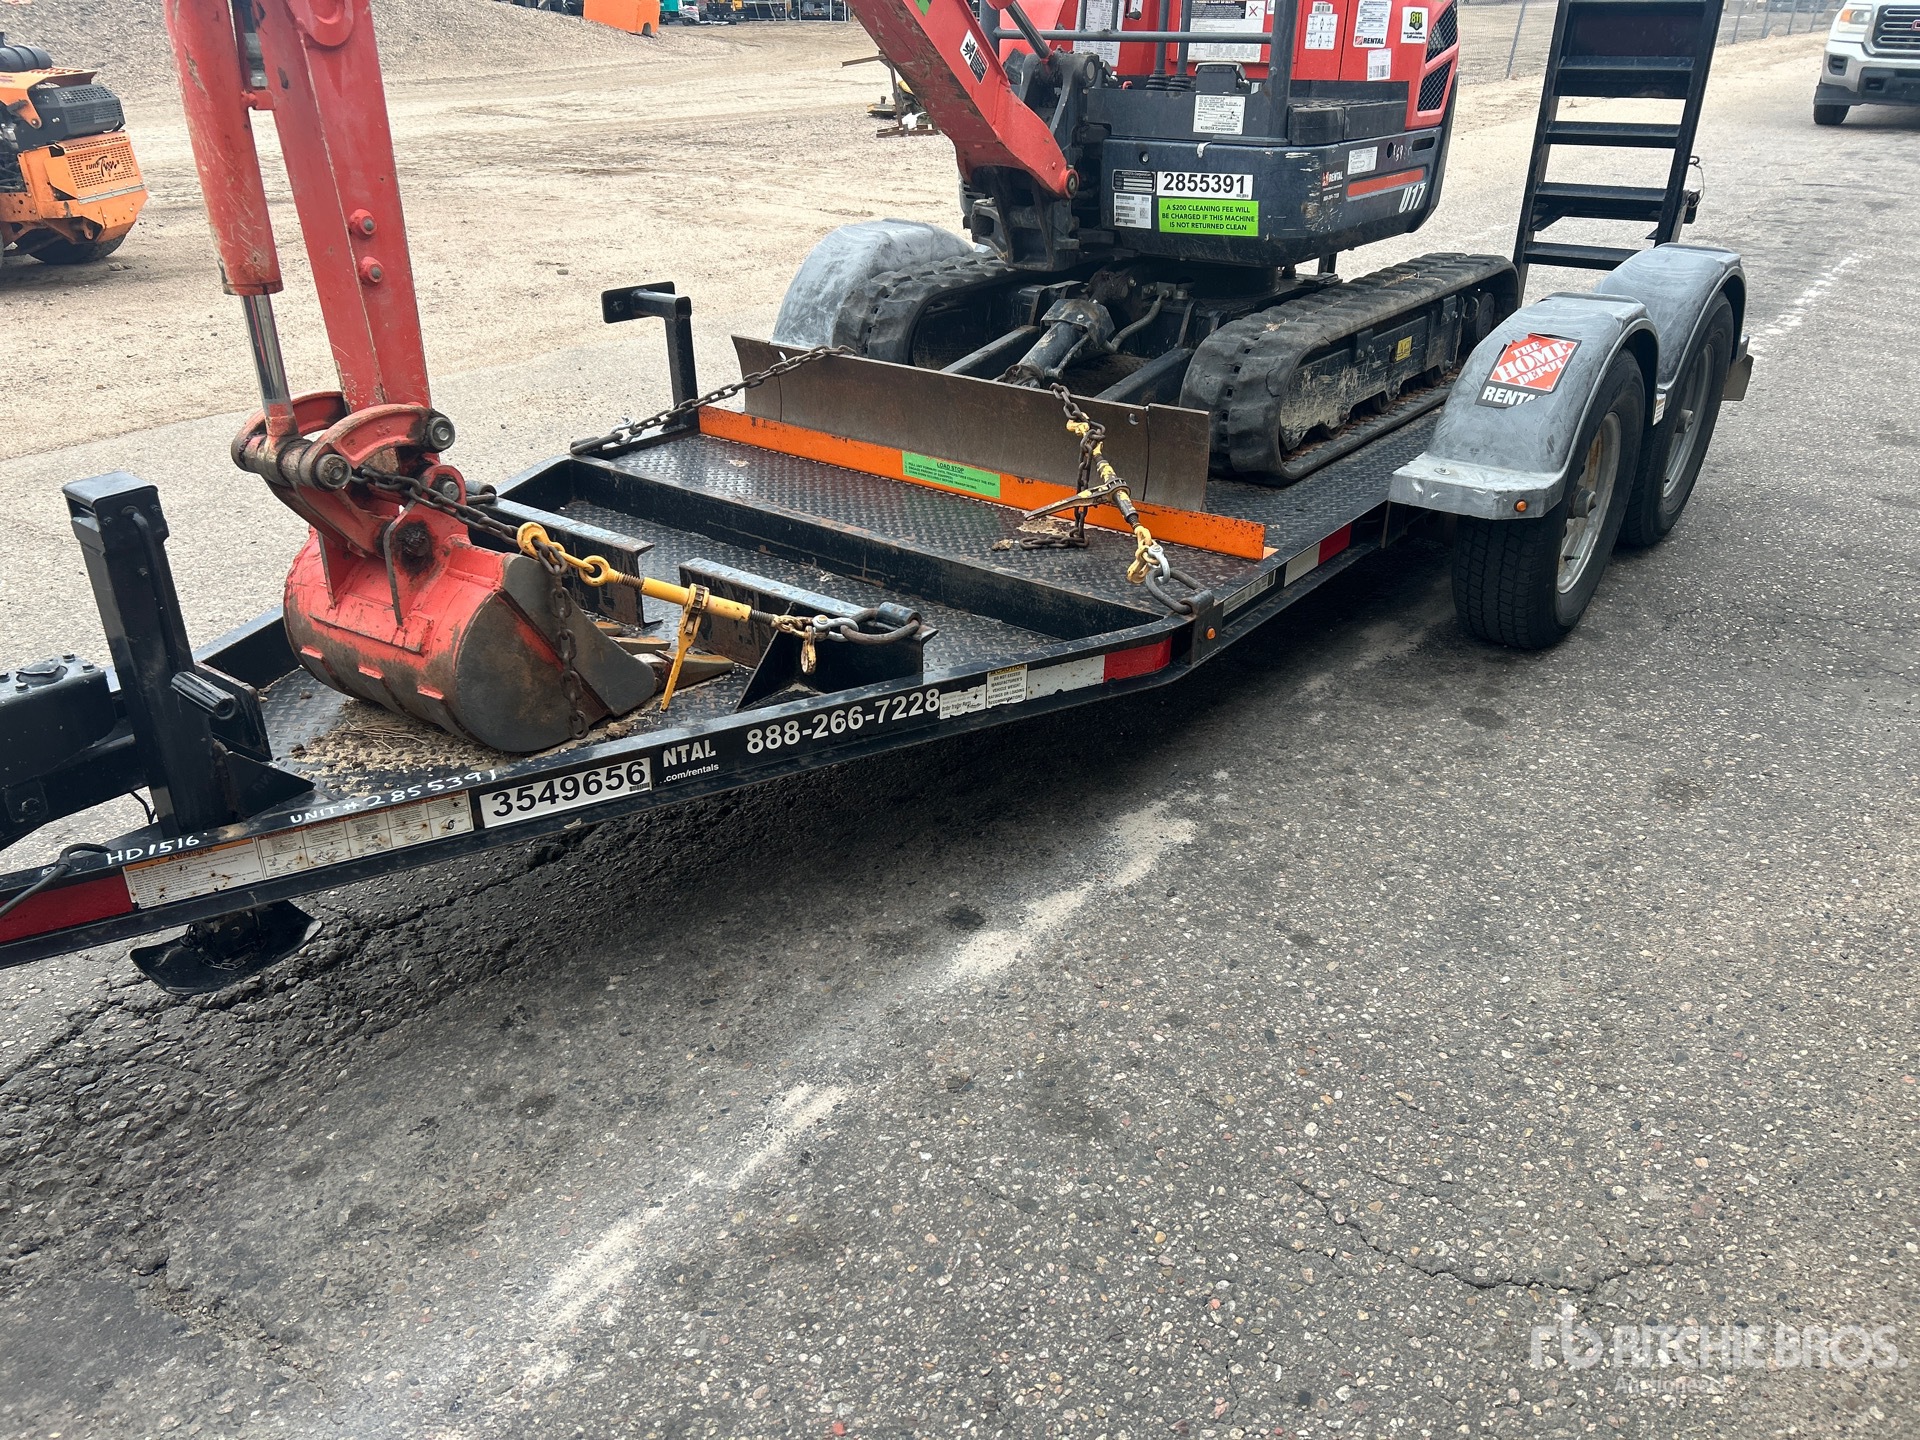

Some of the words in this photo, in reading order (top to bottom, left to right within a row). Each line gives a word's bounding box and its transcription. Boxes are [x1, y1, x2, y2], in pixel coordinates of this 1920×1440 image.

[1363, 37, 1384, 45] RENTAL
[1163, 172, 1245, 195] 2855391
[1398, 182, 1427, 213] U17
[1188, 205, 1220, 213] CLEANING
[1224, 215, 1256, 223] MACHINE
[1191, 222, 1225, 230] RETURNED
[1225, 223, 1247, 231] CLEAN
[1511, 341, 1542, 357] THE
[1495, 341, 1573, 382] HOME
[1516, 358, 1564, 385] DEPOT
[1482, 386, 1542, 406] RENTA
[936, 462, 951, 471] LOAD
[951, 465, 965, 474] STOP
[746, 688, 940, 754] 888-266-7228
[491, 760, 646, 818] 3549656
[105, 835, 200, 865] HD1516
